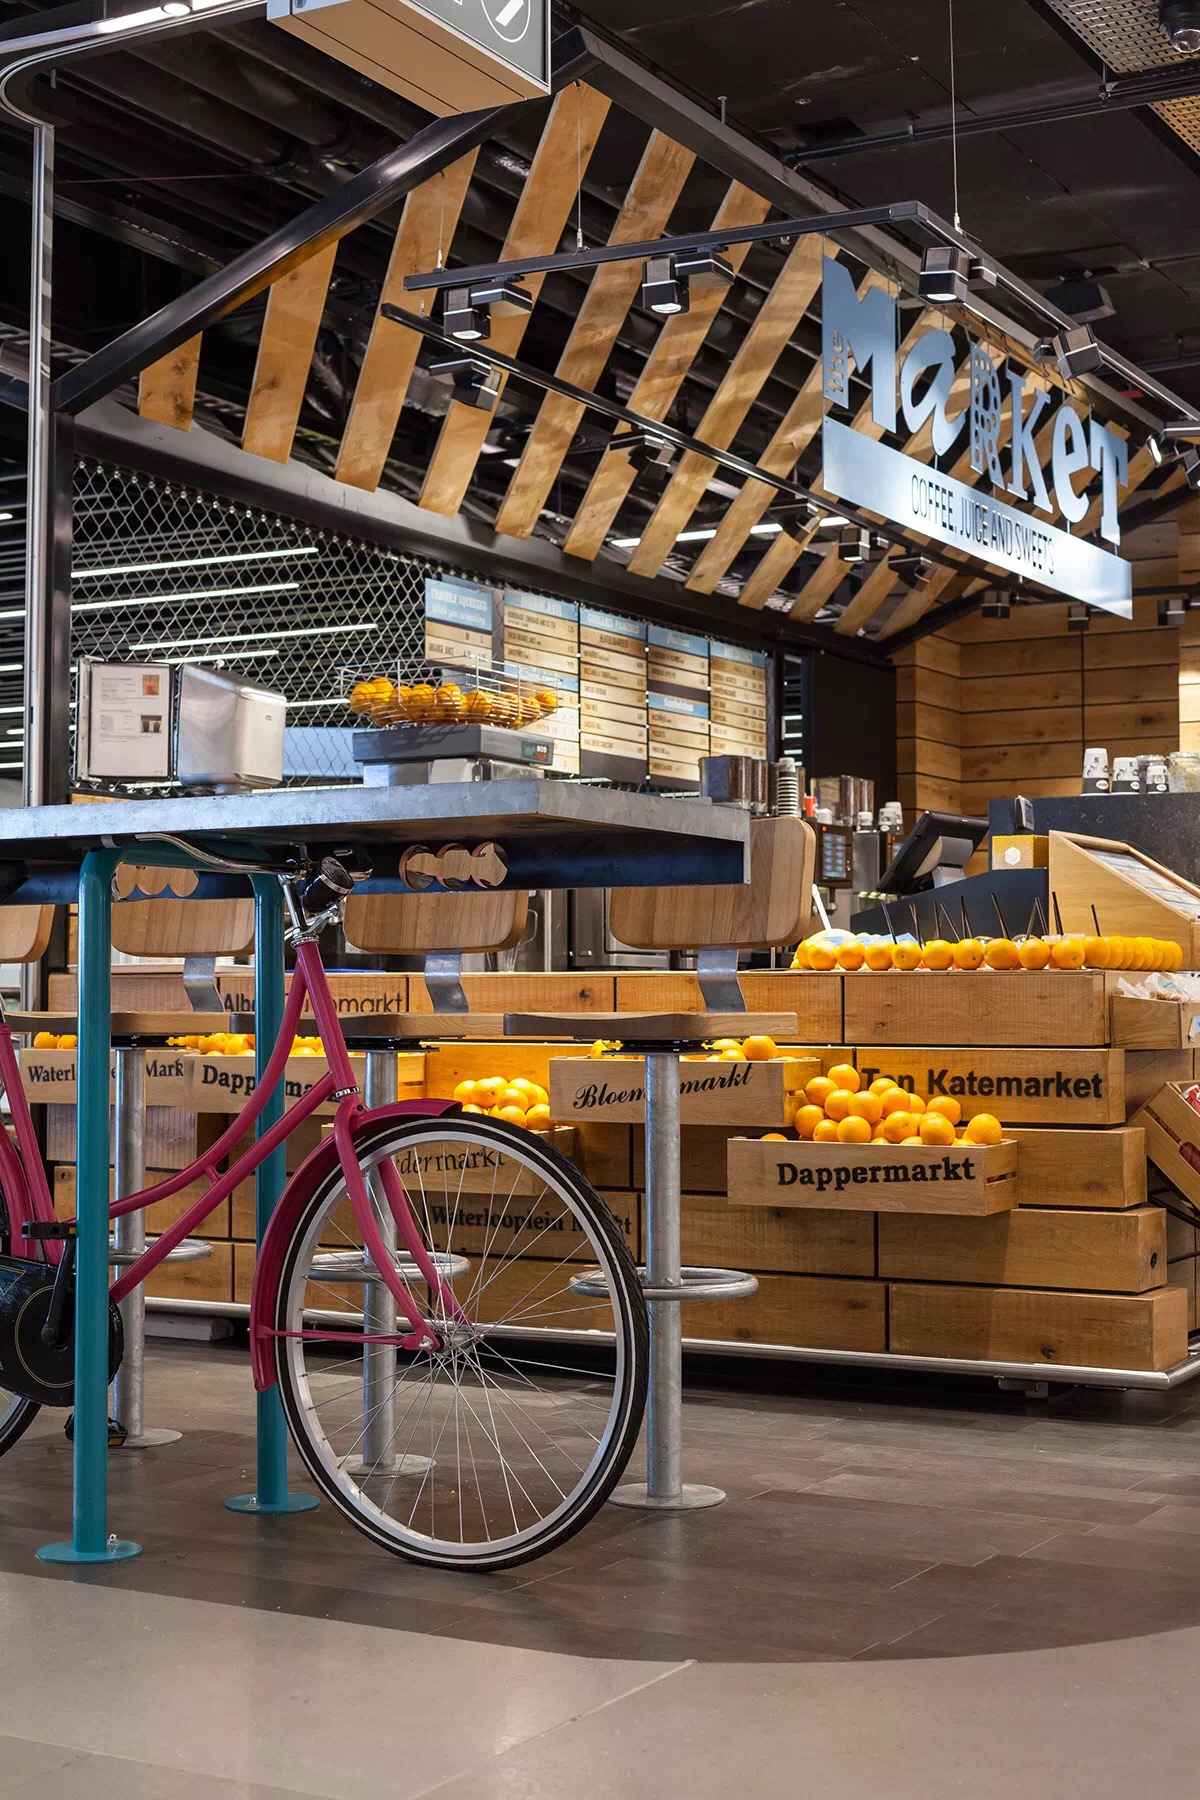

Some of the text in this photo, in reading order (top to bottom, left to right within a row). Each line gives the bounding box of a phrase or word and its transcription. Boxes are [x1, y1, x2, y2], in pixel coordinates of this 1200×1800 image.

[827, 329, 844, 393] the
[911, 474, 1056, 575] COFFEE, JUICE AND SWEETS
[573, 1063, 754, 1109] Bloemmarkt
[861, 1068, 1103, 1098] Tn Katemarket
[777, 1156, 976, 1191] Dappermarkt
[431, 1206, 563, 1234] Waterlooplein
